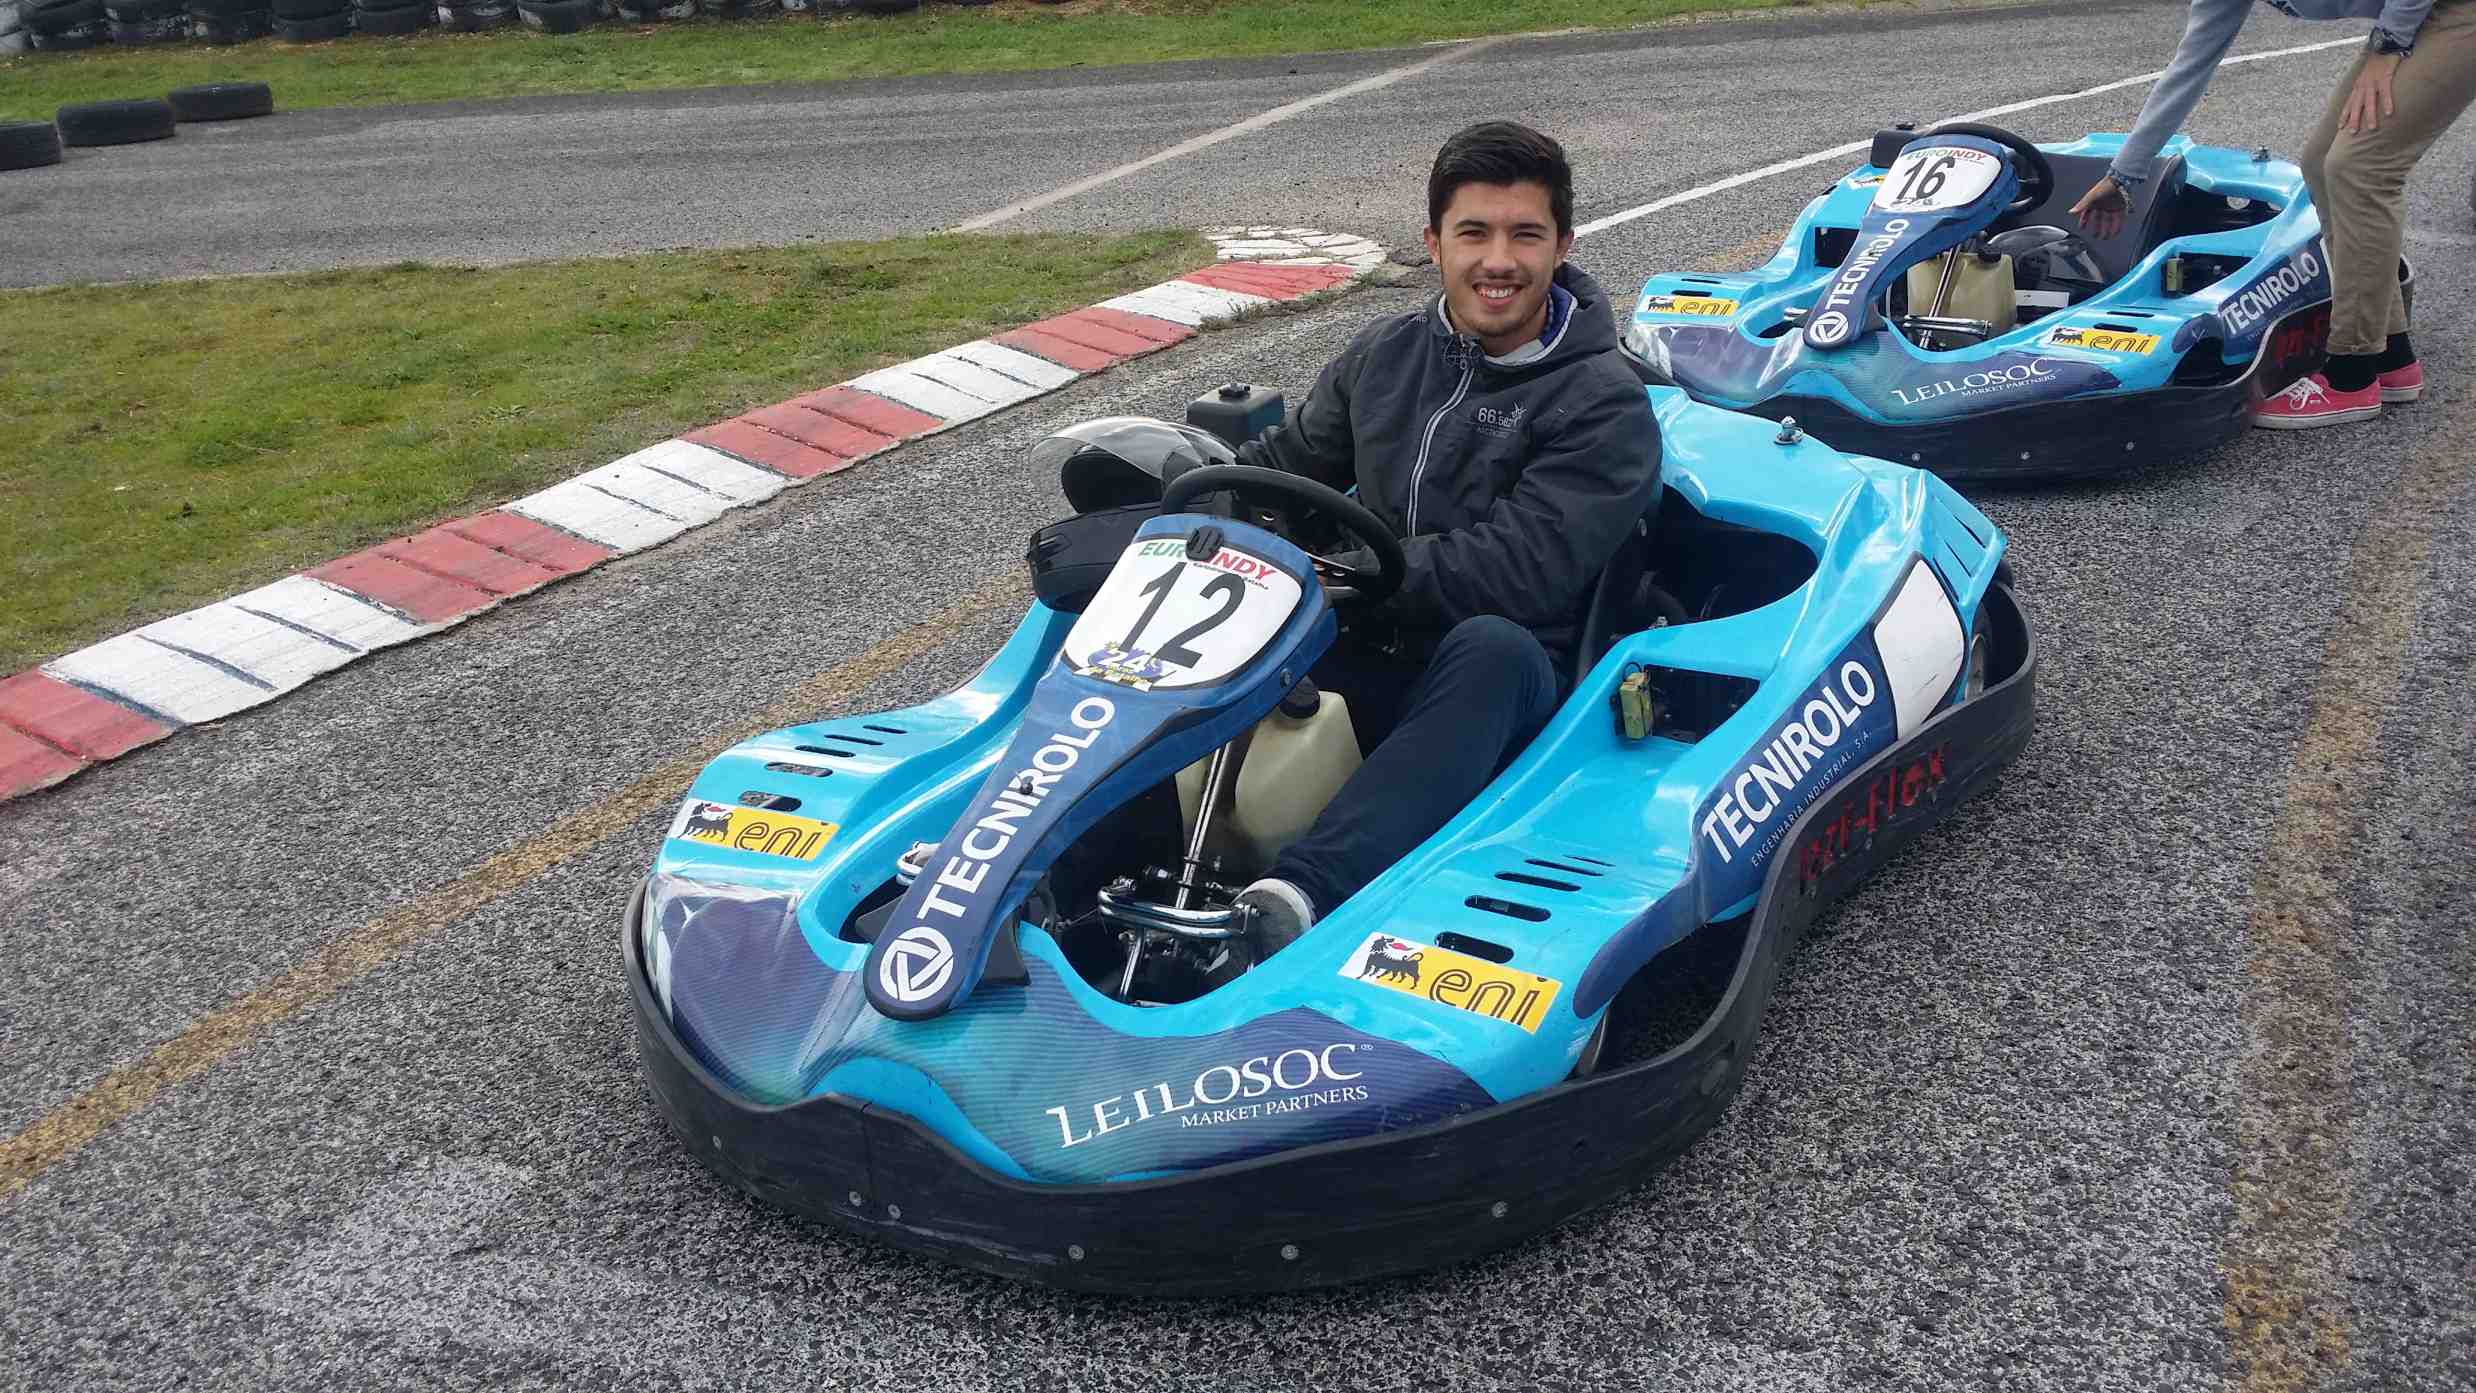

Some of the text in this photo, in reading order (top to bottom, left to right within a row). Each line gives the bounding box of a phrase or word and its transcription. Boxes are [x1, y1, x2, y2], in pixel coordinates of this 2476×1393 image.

[1896, 156, 1956, 200] 16
[1825, 219, 1910, 310] TECNIROLO
[2221, 252, 2320, 334] TECNIROLO
[1680, 299, 1733, 316] eni
[2089, 334, 2152, 353] eni
[1891, 358, 2053, 405] LEILOSOC
[1961, 374, 2057, 398] MARKET PARTNERS
[1139, 561, 1247, 669] 12
[1700, 660, 1875, 864] TECNIROLO
[916, 697, 1115, 919] TECNIROLO
[1751, 804, 1805, 866] ENGENHARIA
[734, 822, 829, 858] eni
[1428, 968, 1548, 1026] eni
[1046, 1043, 1363, 1148] LEILOSOC
[1181, 1085, 1369, 1129] MARKET PARTNERS
